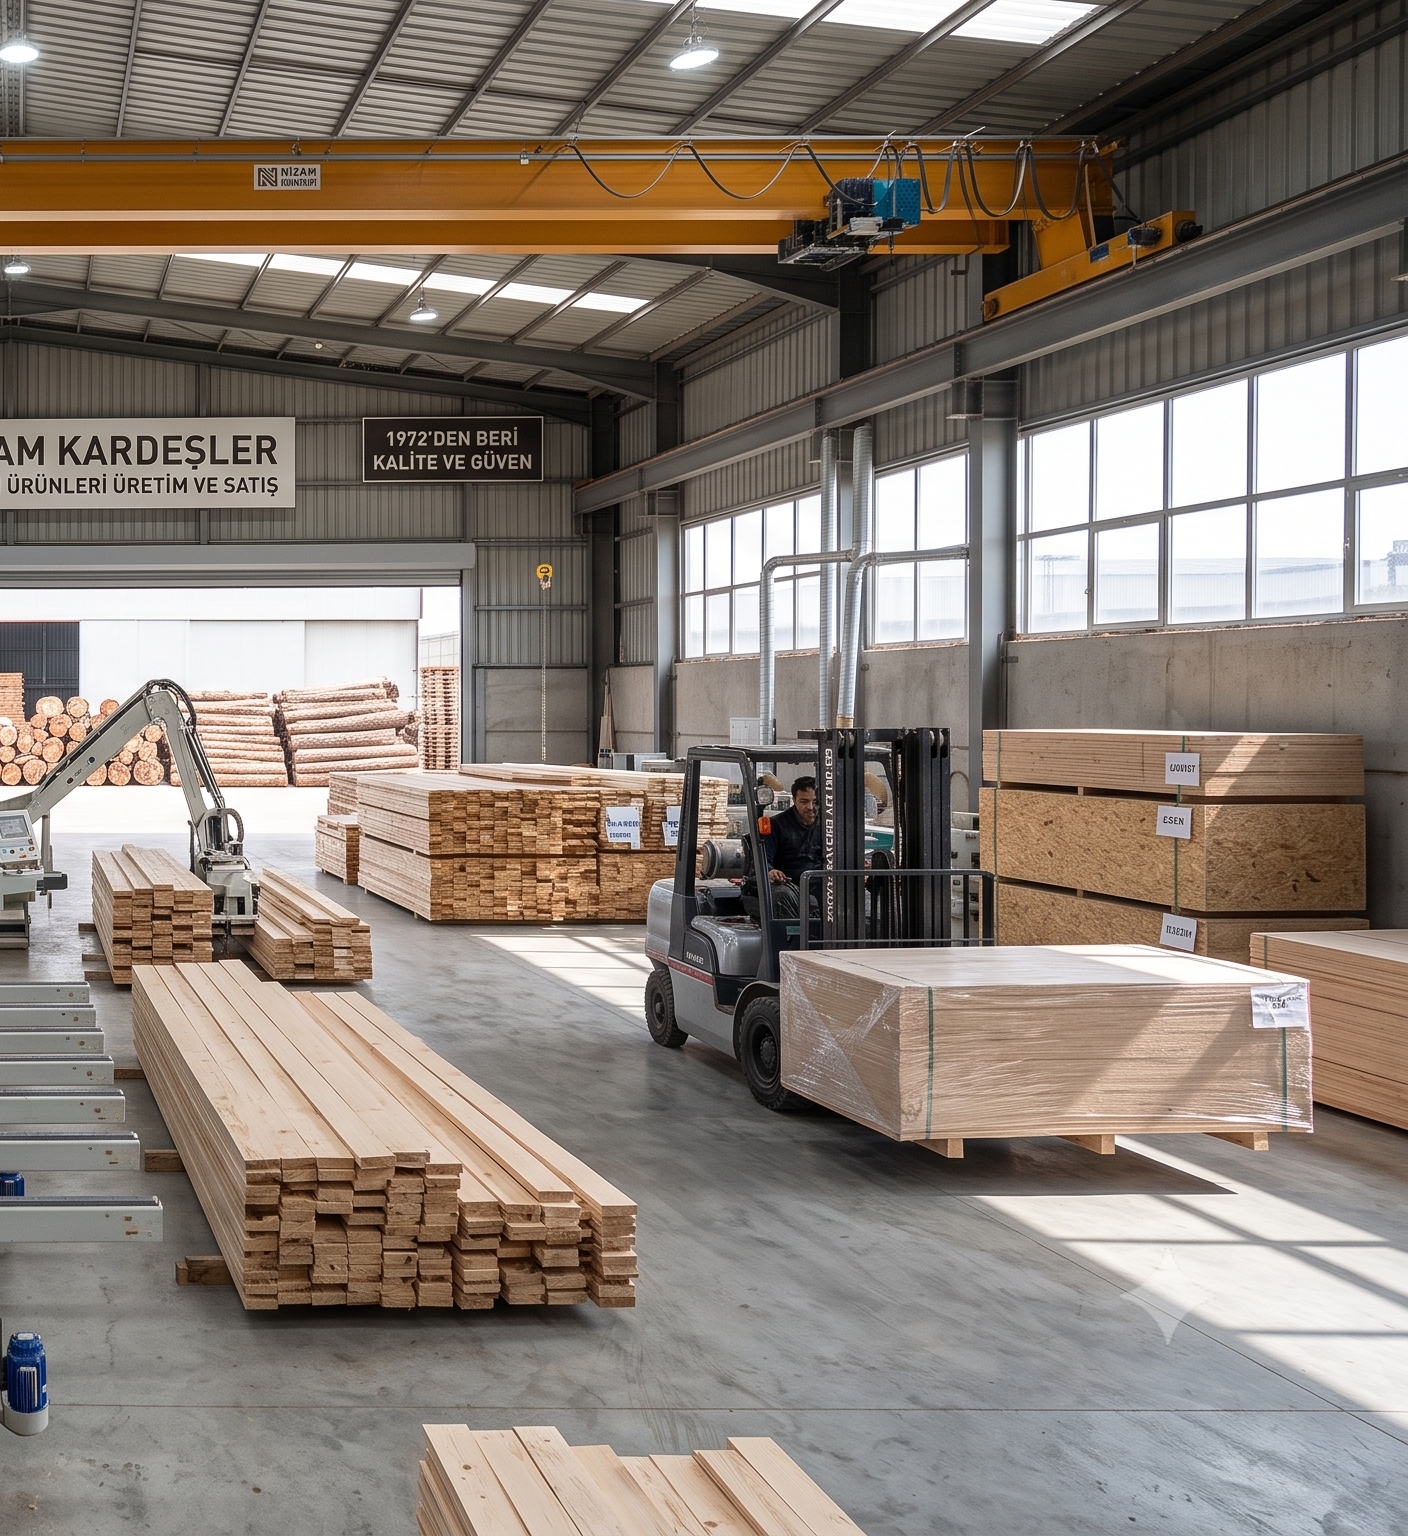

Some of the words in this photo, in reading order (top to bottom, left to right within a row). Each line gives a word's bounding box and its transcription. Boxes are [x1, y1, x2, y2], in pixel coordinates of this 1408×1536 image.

[477, 427, 517, 445] BERİ
[59, 435, 277, 470] KARDEŞLER
[374, 451, 437, 470] KALİTE
[443, 455, 465, 469] VE
[471, 451, 531, 469] GÜVEN
[8, 474, 106, 494] ÜRÜNLERİ
[114, 473, 187, 493] ÜRETİM
[194, 477, 218, 493] VE
[224, 477, 278, 496] SATIŞ
